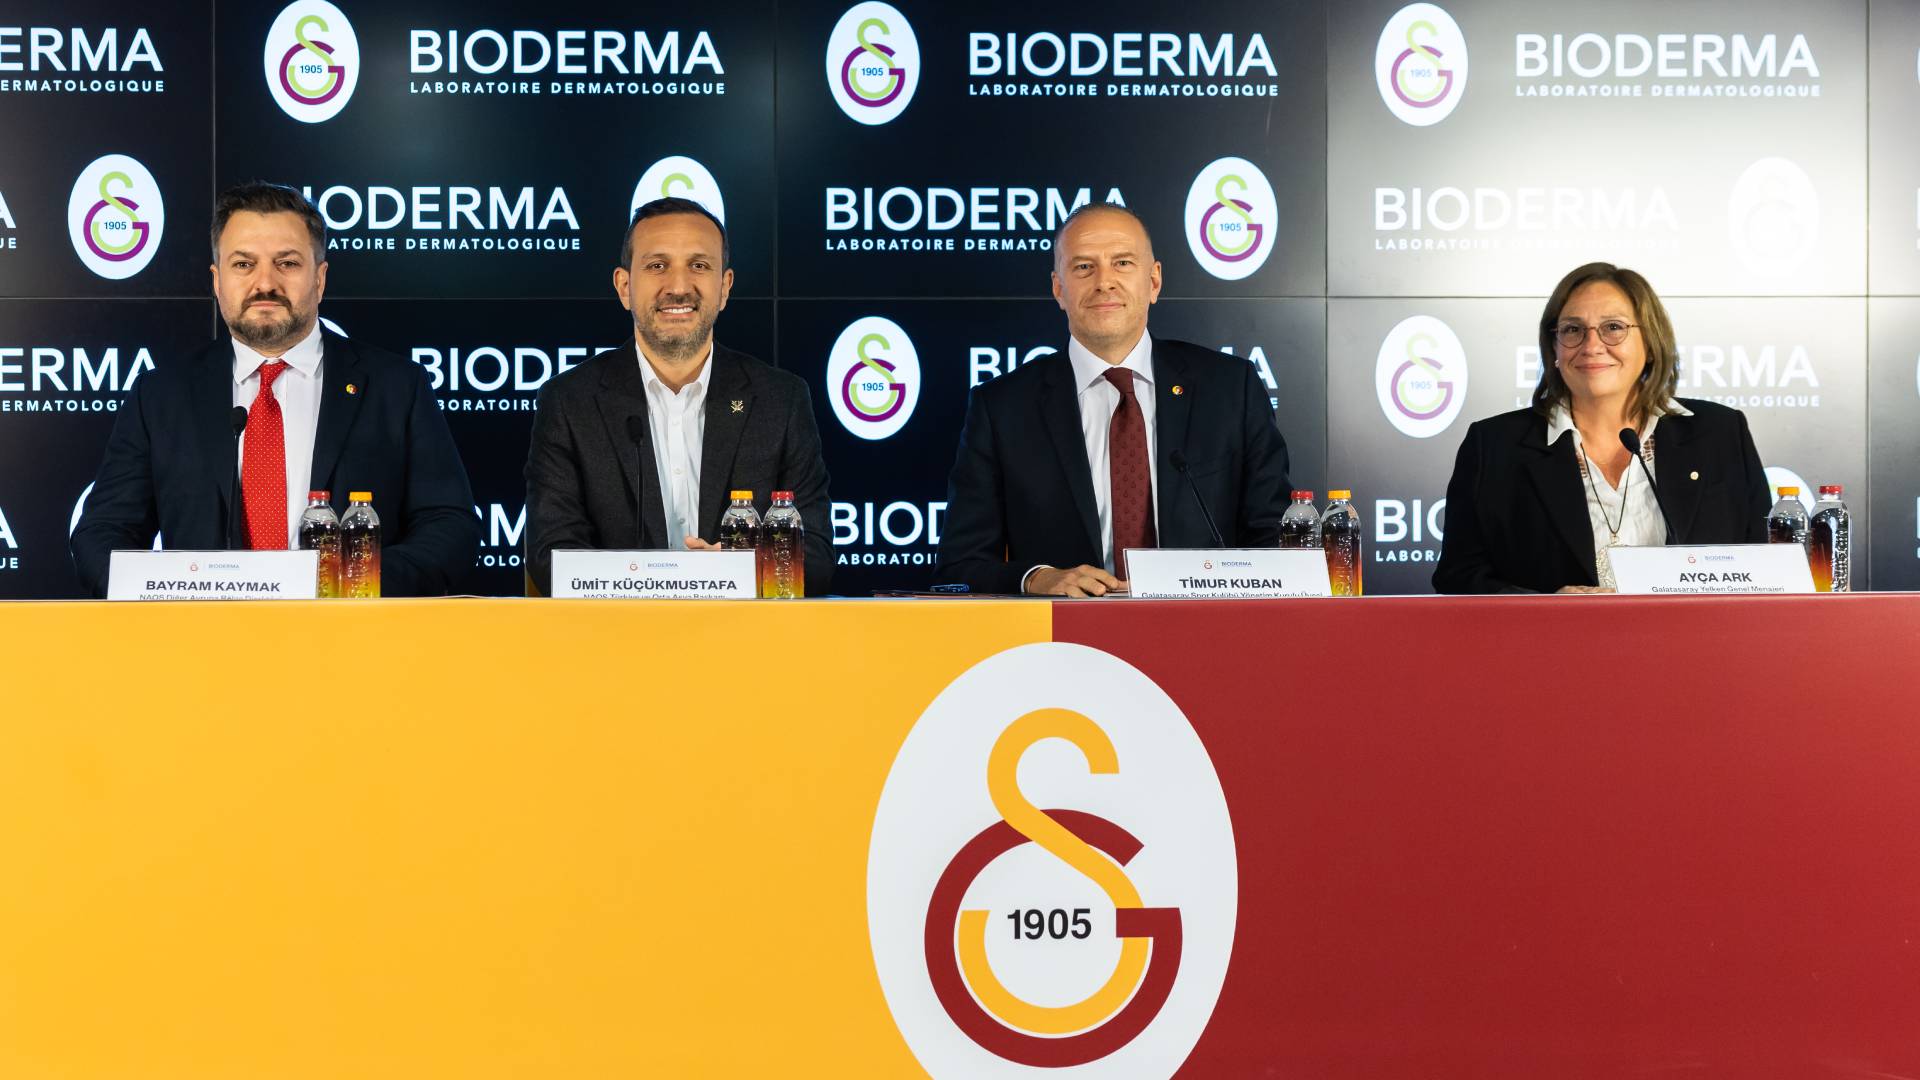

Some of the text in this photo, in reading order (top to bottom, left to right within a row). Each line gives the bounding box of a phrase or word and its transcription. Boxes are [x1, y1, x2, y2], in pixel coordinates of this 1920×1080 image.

[0, 28, 163, 71] ERMA
[411, 30, 724, 74] BIODERMA
[970, 32, 1278, 76] BIODERMA
[1516, 33, 1820, 78] BIODERMA
[301, 64, 323, 74] 1905
[862, 67, 884, 77] 1905
[1, 80, 163, 91] ERMATOLOGIQUE
[411, 82, 725, 94] LABORATOIRE DERMATOLOGIQUE
[970, 84, 1278, 96] LABORATOIRE DERMATOLOGIQUE
[1516, 85, 1820, 97] LABORATOIRE DERMATOLOGIQUE
[303, 186, 580, 231] ODERMA
[1375, 187, 1678, 232] BIODERMA
[104, 221, 127, 230] 1905
[1219, 222, 1242, 232] 1905
[327, 238, 580, 249] ATOIRE DERMATOLOGIQUE
[826, 239, 1051, 250] LABORATOIRE DERMATO
[0, 347, 156, 391] ERMA
[862, 382, 884, 392] 1905
[3, 400, 123, 411] ERMATOLOG
[438, 400, 537, 411] BORATOIR
[831, 501, 948, 546] BIOD
[838, 553, 936, 565] ABORATOI
[572, 577, 737, 592] ÜMİT KÜÇÜKMUSTAFA
[1179, 576, 1282, 589] TİMUR KUBAN
[1679, 573, 1752, 584] AYÇA ARK
[146, 581, 281, 592] BAYRAM KAYMAK
[1007, 908, 1092, 940] 1905
